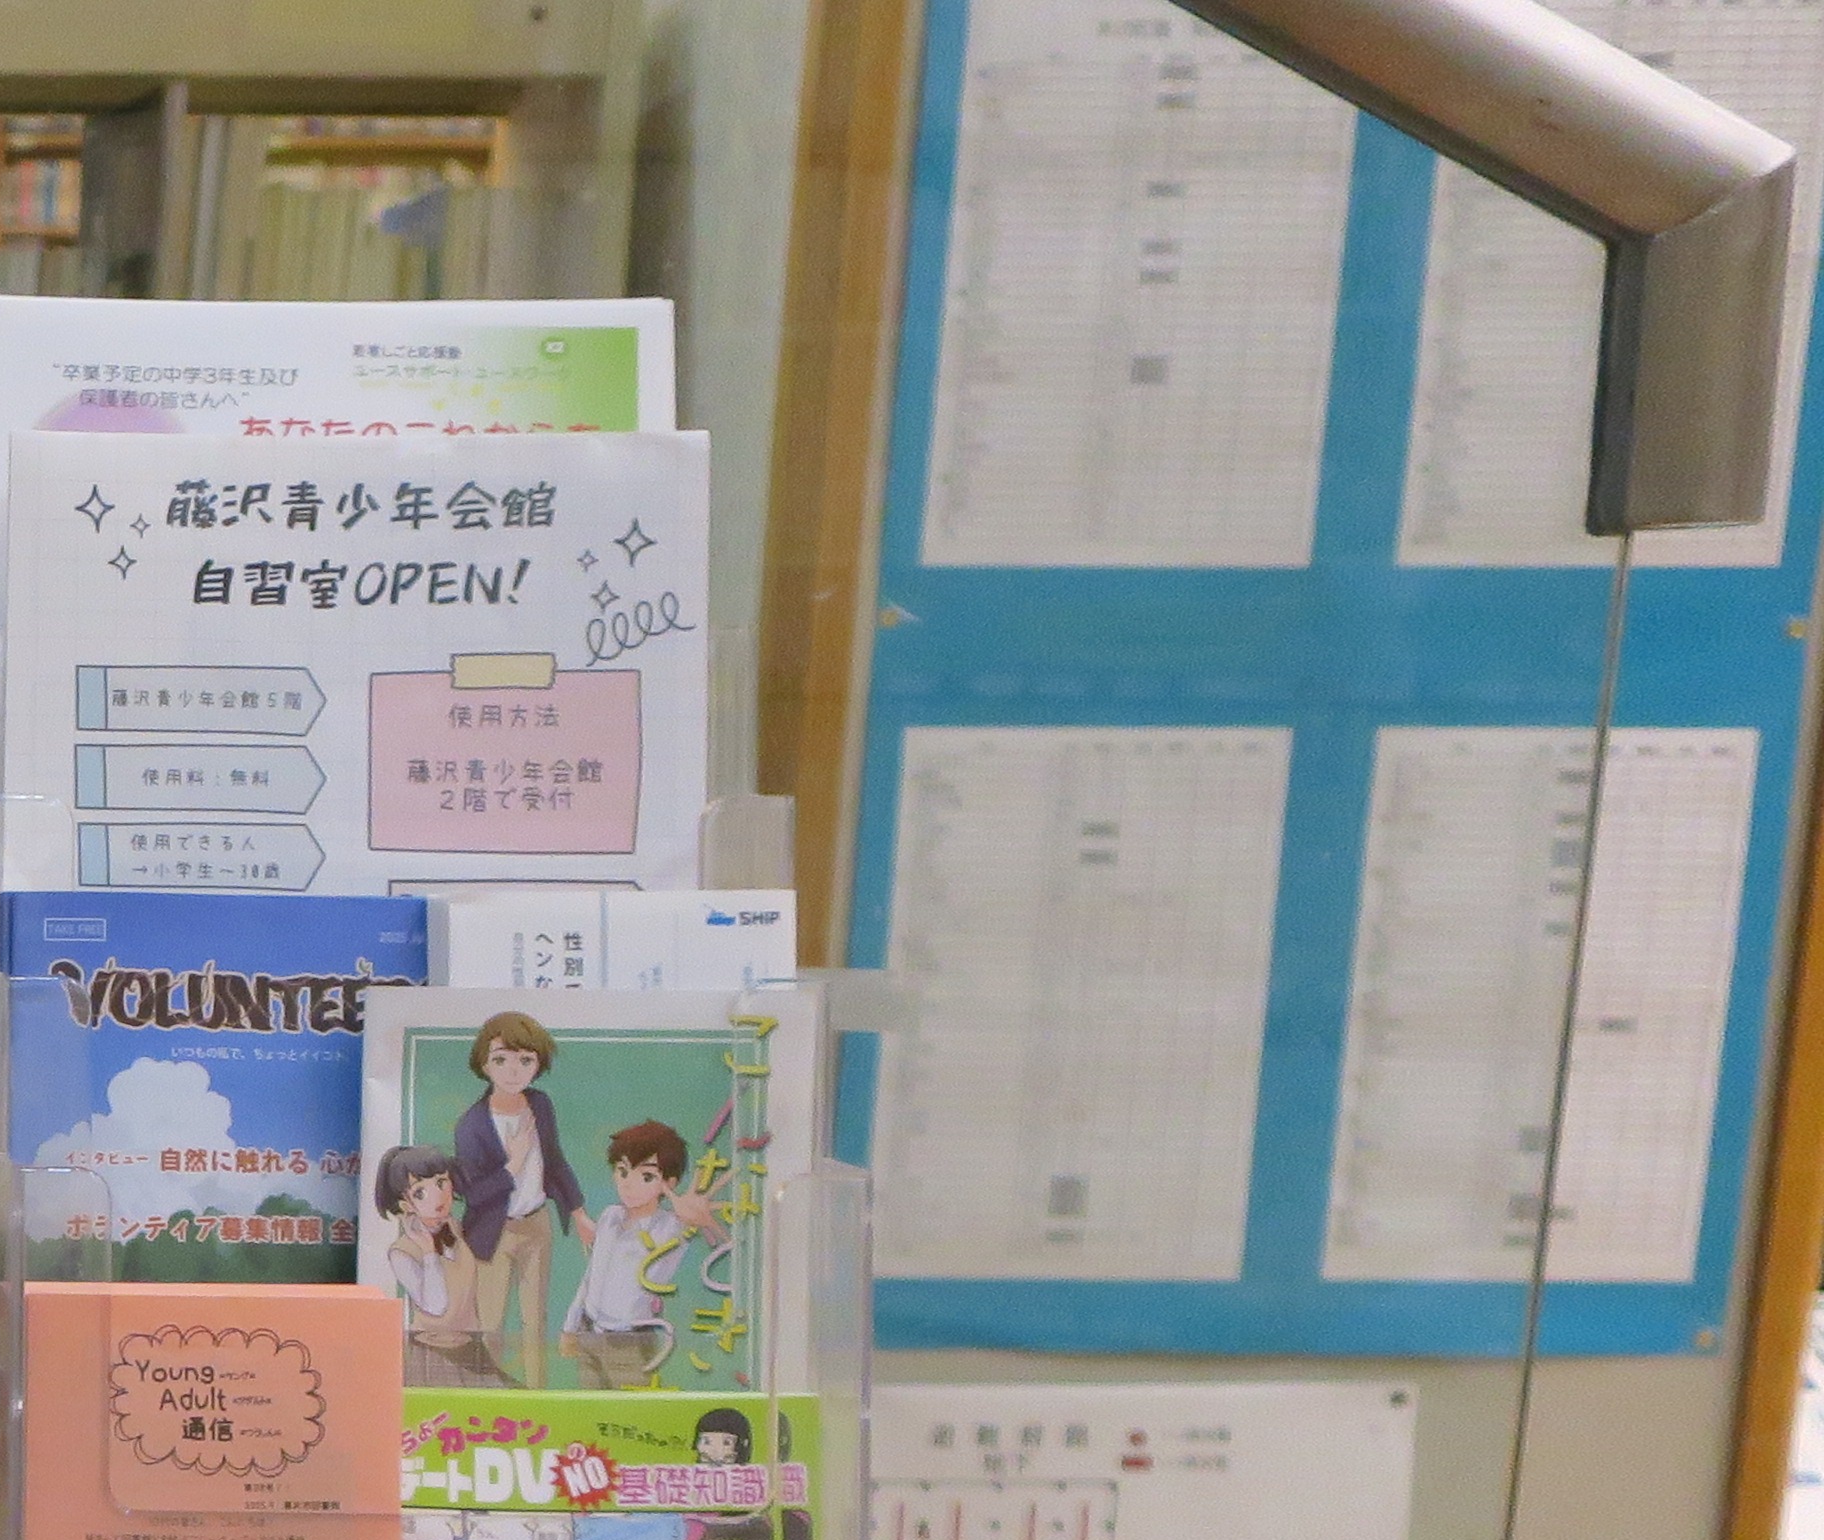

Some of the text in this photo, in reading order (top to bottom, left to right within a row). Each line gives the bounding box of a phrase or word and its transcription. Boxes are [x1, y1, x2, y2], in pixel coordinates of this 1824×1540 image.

[166, 479, 557, 532] 藤沢青少年会館
[448, 703, 560, 729] 使用方法
[407, 758, 604, 785] 藤沢青少年会館
[439, 787, 573, 813] 2階で受付
[131, 834, 255, 851] 使用できる人
[740, 911, 780, 926] SHIP
[564, 932, 583, 988] 性別
[50, 962, 419, 1034] VOLUNTEE
[64, 1152, 149, 1165] インタビュー
[160, 1148, 309, 1175] 自然に触れる
[66, 1214, 322, 1244] ボランティア募集情報
[136, 1360, 214, 1384] Young
[160, 1387, 226, 1411] Adult
[182, 1417, 234, 1441] 通信
[562, 1455, 611, 1496] NO
[617, 1465, 767, 1505] 基礎知識
